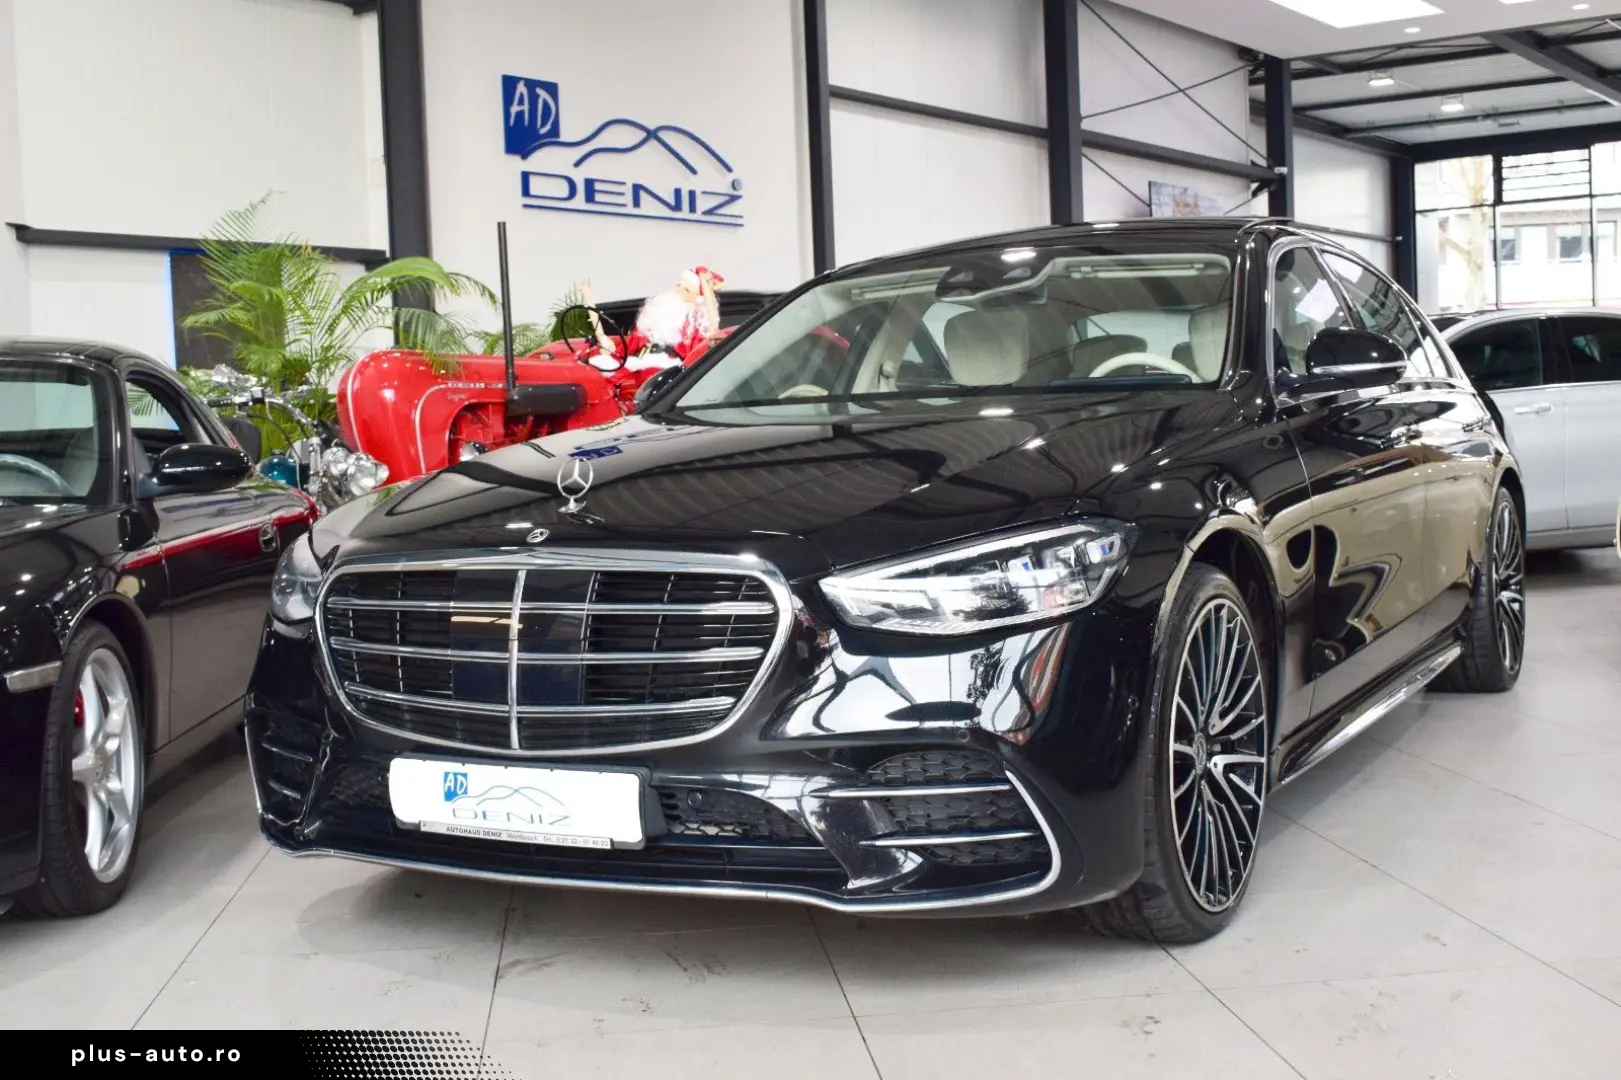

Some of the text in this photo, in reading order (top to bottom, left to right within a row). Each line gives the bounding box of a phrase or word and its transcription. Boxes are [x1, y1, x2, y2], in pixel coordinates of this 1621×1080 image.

[509, 79, 556, 135] AD
[520, 169, 744, 219] DENIZ
[444, 772, 467, 795] AD
[452, 807, 573, 826] DENIZ
[446, 826, 481, 836] AUTOHAUS
[482, 829, 502, 838] DENIZ
